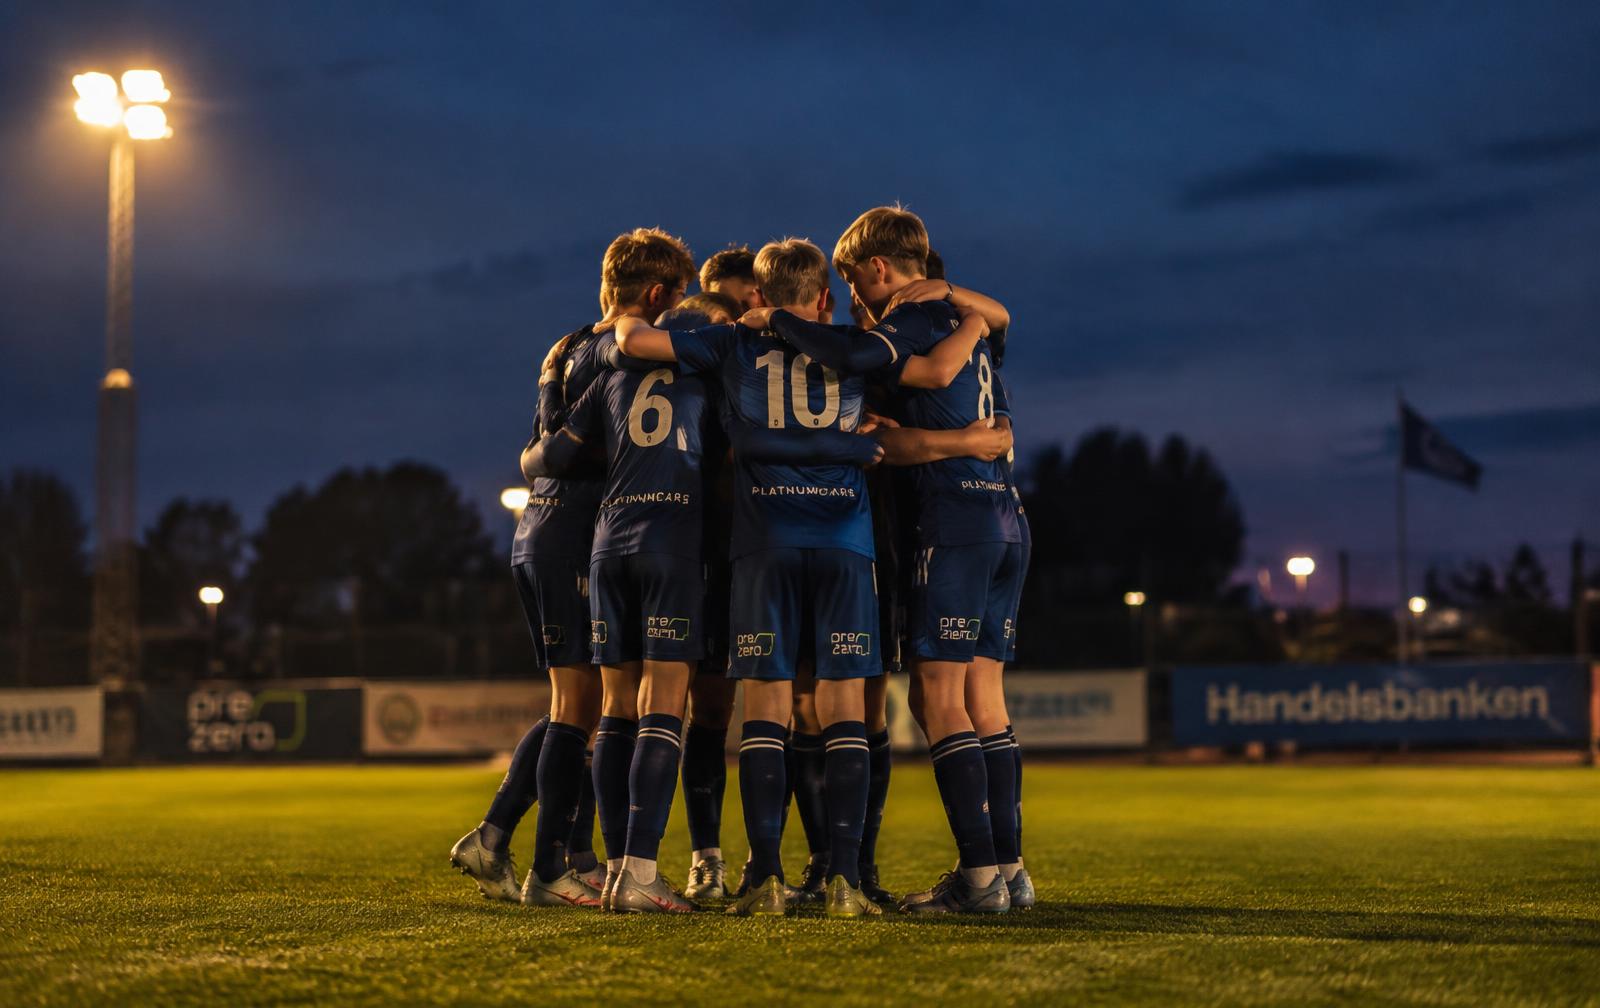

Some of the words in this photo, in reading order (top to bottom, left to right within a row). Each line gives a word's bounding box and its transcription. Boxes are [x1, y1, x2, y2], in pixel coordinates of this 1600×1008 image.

[628, 368, 674, 448] 6
[755, 350, 841, 430] 10
[977, 353, 994, 429] 8
[737, 633, 755, 647] pre
[831, 632, 856, 644] pre
[940, 617, 966, 632] pre
[737, 645, 762, 658] zero
[187, 689, 254, 734] pre
[1206, 680, 1549, 726] Handelsbanken
[188, 722, 276, 752] zero
